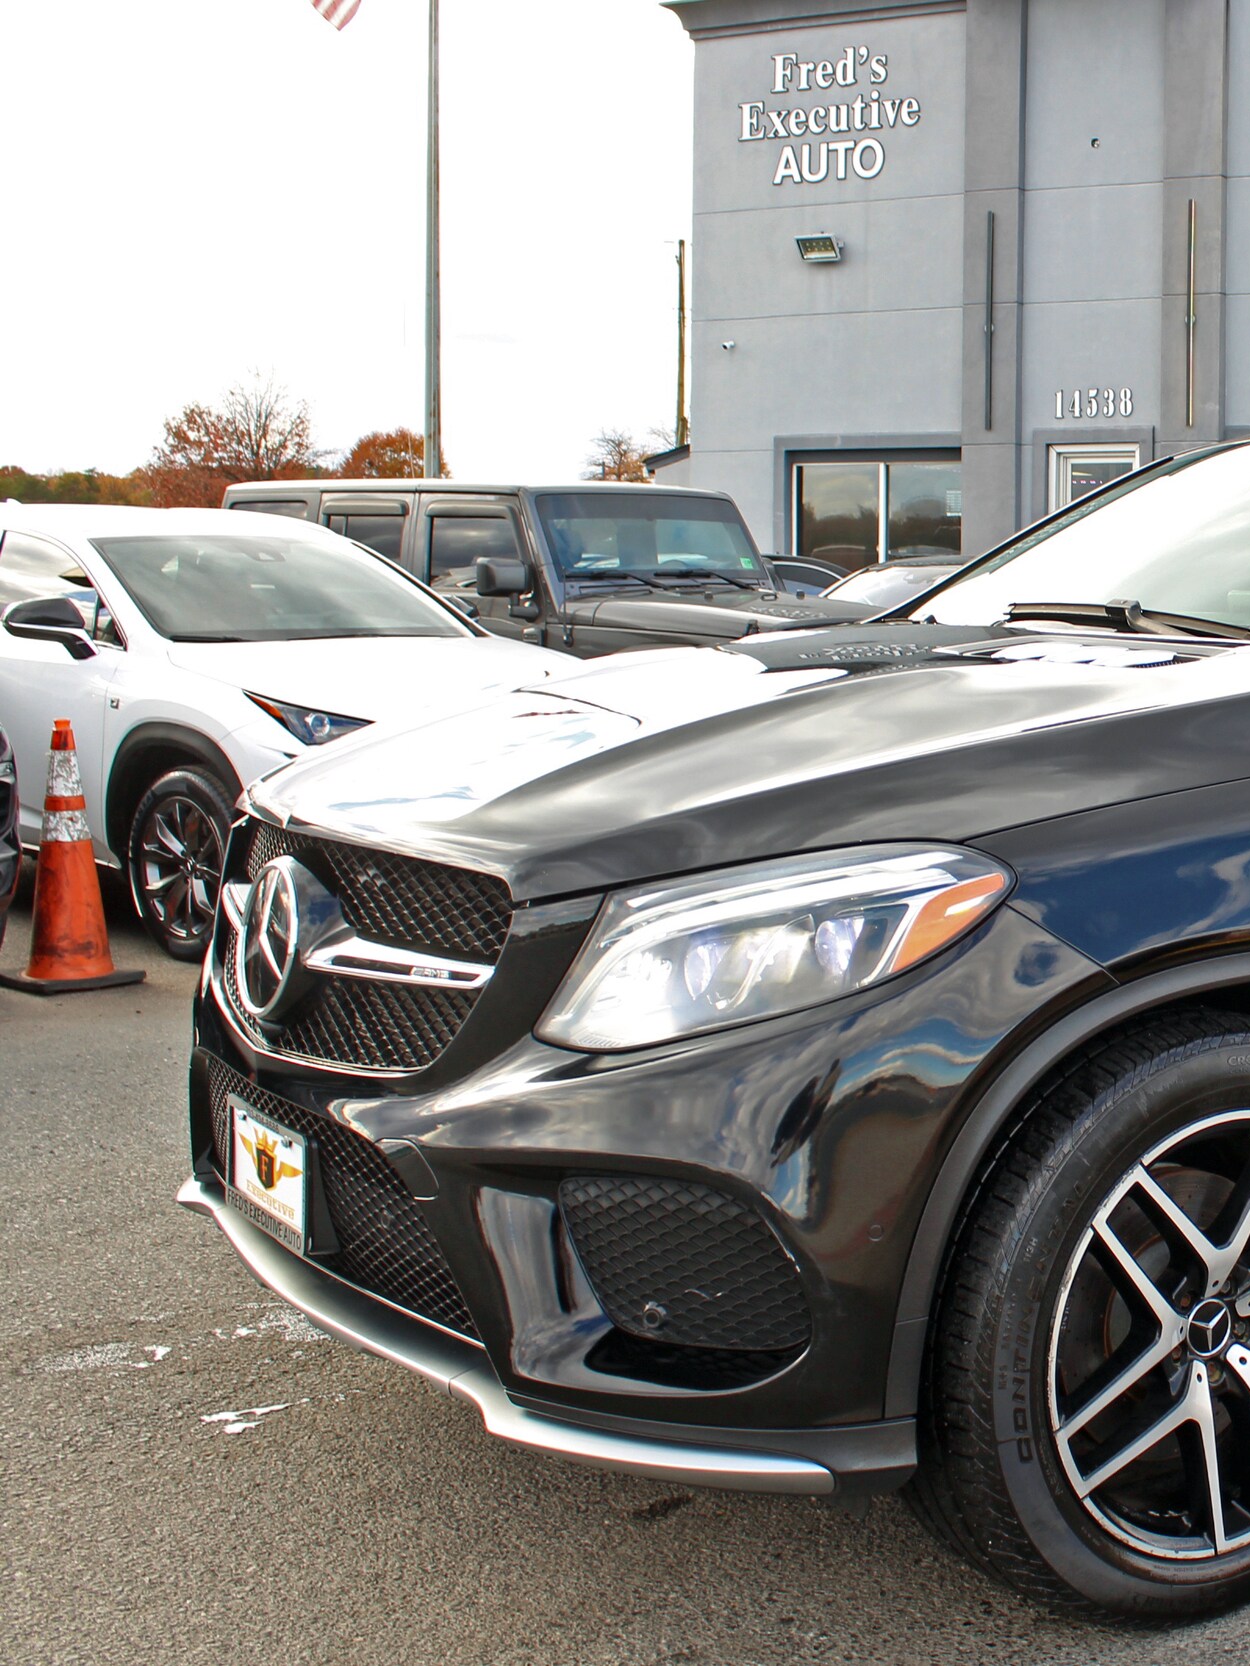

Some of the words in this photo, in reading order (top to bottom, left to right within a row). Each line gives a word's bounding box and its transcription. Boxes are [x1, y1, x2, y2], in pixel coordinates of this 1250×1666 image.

[770, 45, 888, 93] Fred's
[738, 89, 921, 142] Executive
[772, 138, 885, 185] AUTO
[1055, 387, 1133, 419] 14538
[283, 1223, 302, 1251] AUTO
